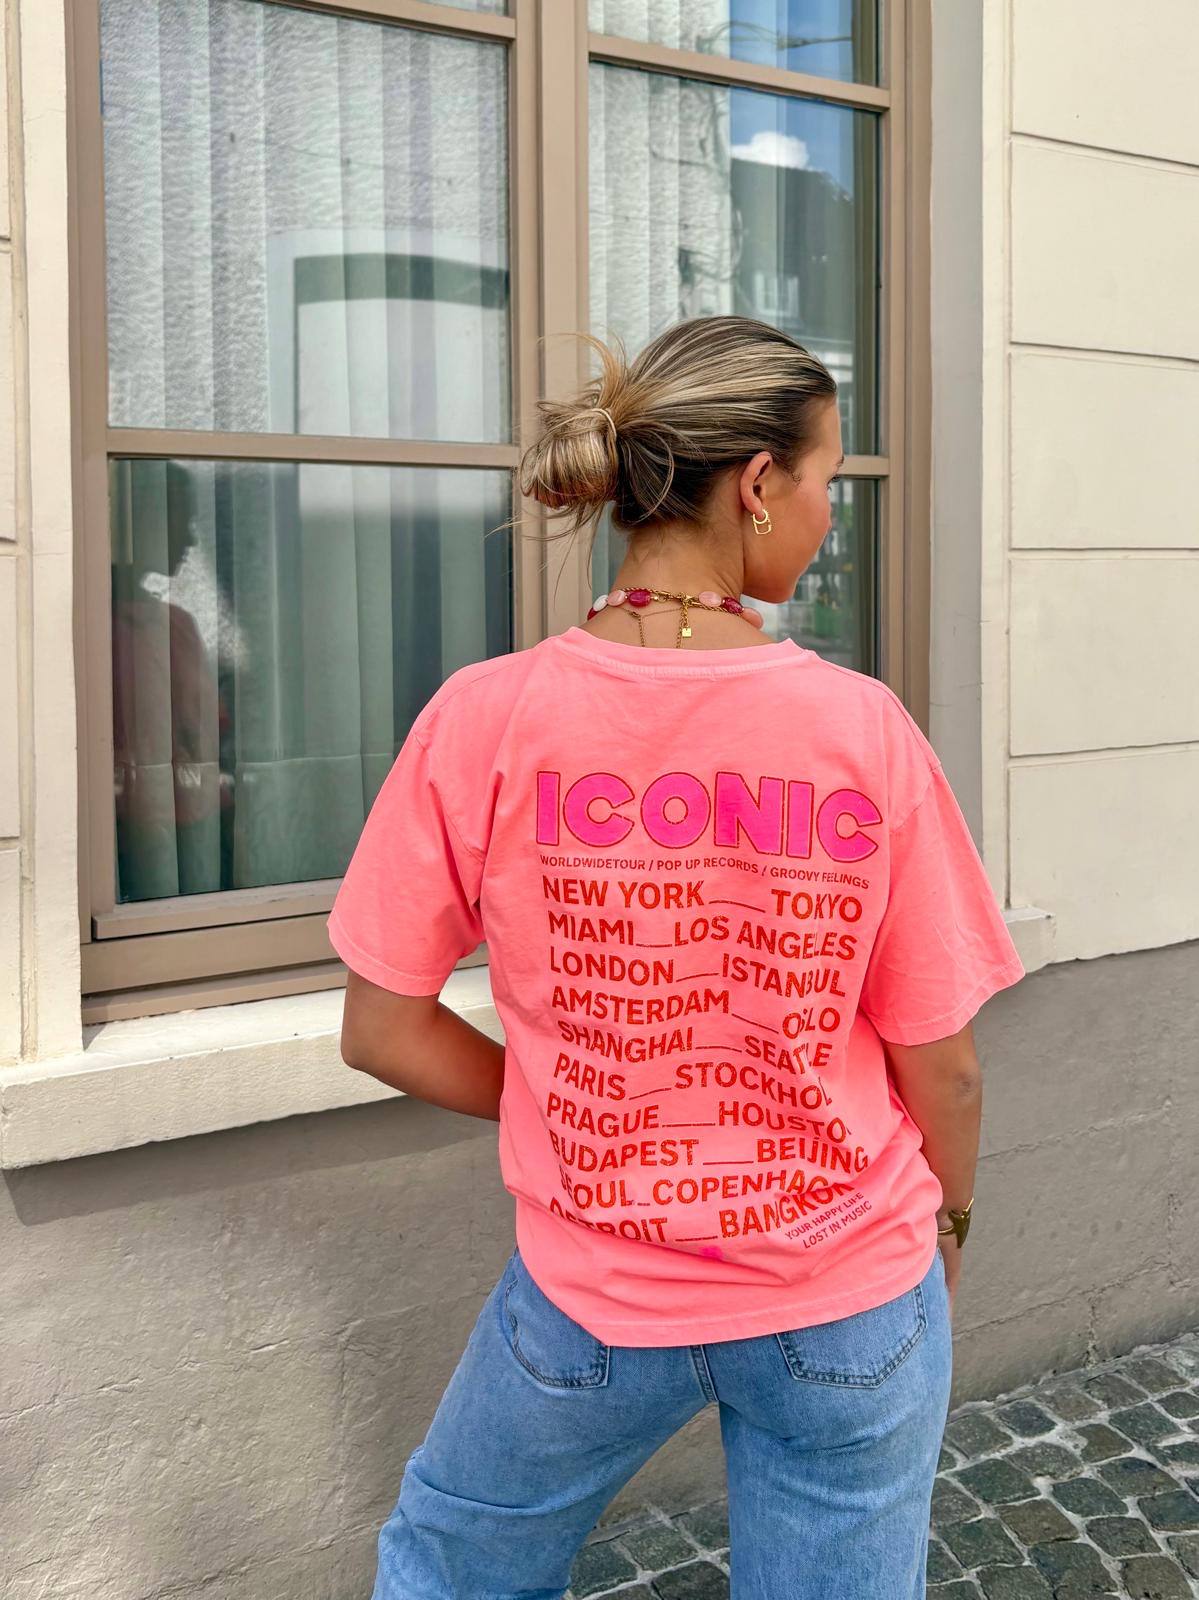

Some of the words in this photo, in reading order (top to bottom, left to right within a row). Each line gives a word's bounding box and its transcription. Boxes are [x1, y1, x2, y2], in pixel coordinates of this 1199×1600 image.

[536, 771, 882, 863] ICONIC
[540, 855, 645, 871] WORLDWIDETOUR
[657, 860, 682, 871] POP
[686, 859, 700, 870] UP
[704, 857, 758, 873] RECORDS
[770, 867, 820, 882] GROOVY
[822, 872, 870, 889] FEELINGS
[543, 875, 608, 906] NEW
[618, 880, 704, 909] YORK
[771, 889, 862, 923] TOKYO
[548, 911, 634, 945] MIAMI
[675, 916, 730, 947] LOS
[737, 921, 857, 960] ANGELES
[550, 947, 674, 986] LONDON
[552, 986, 729, 1025] AMSTERDAM
[557, 1020, 693, 1063] SHANGHAI
[554, 1053, 626, 1100] PARIS
[547, 1092, 659, 1137] PRAGUE
[718, 1100, 851, 1143] HOUSTO
[549, 1129, 699, 1173] BUDAPEST
[757, 1136, 868, 1174] BEIJING
[785, 1222, 813, 1240] YOUR
[812, 1205, 845, 1227] HAPPY
[803, 1228, 828, 1248] LOST
[829, 1221, 842, 1235] IN
[841, 1201, 872, 1226] MUSIC
